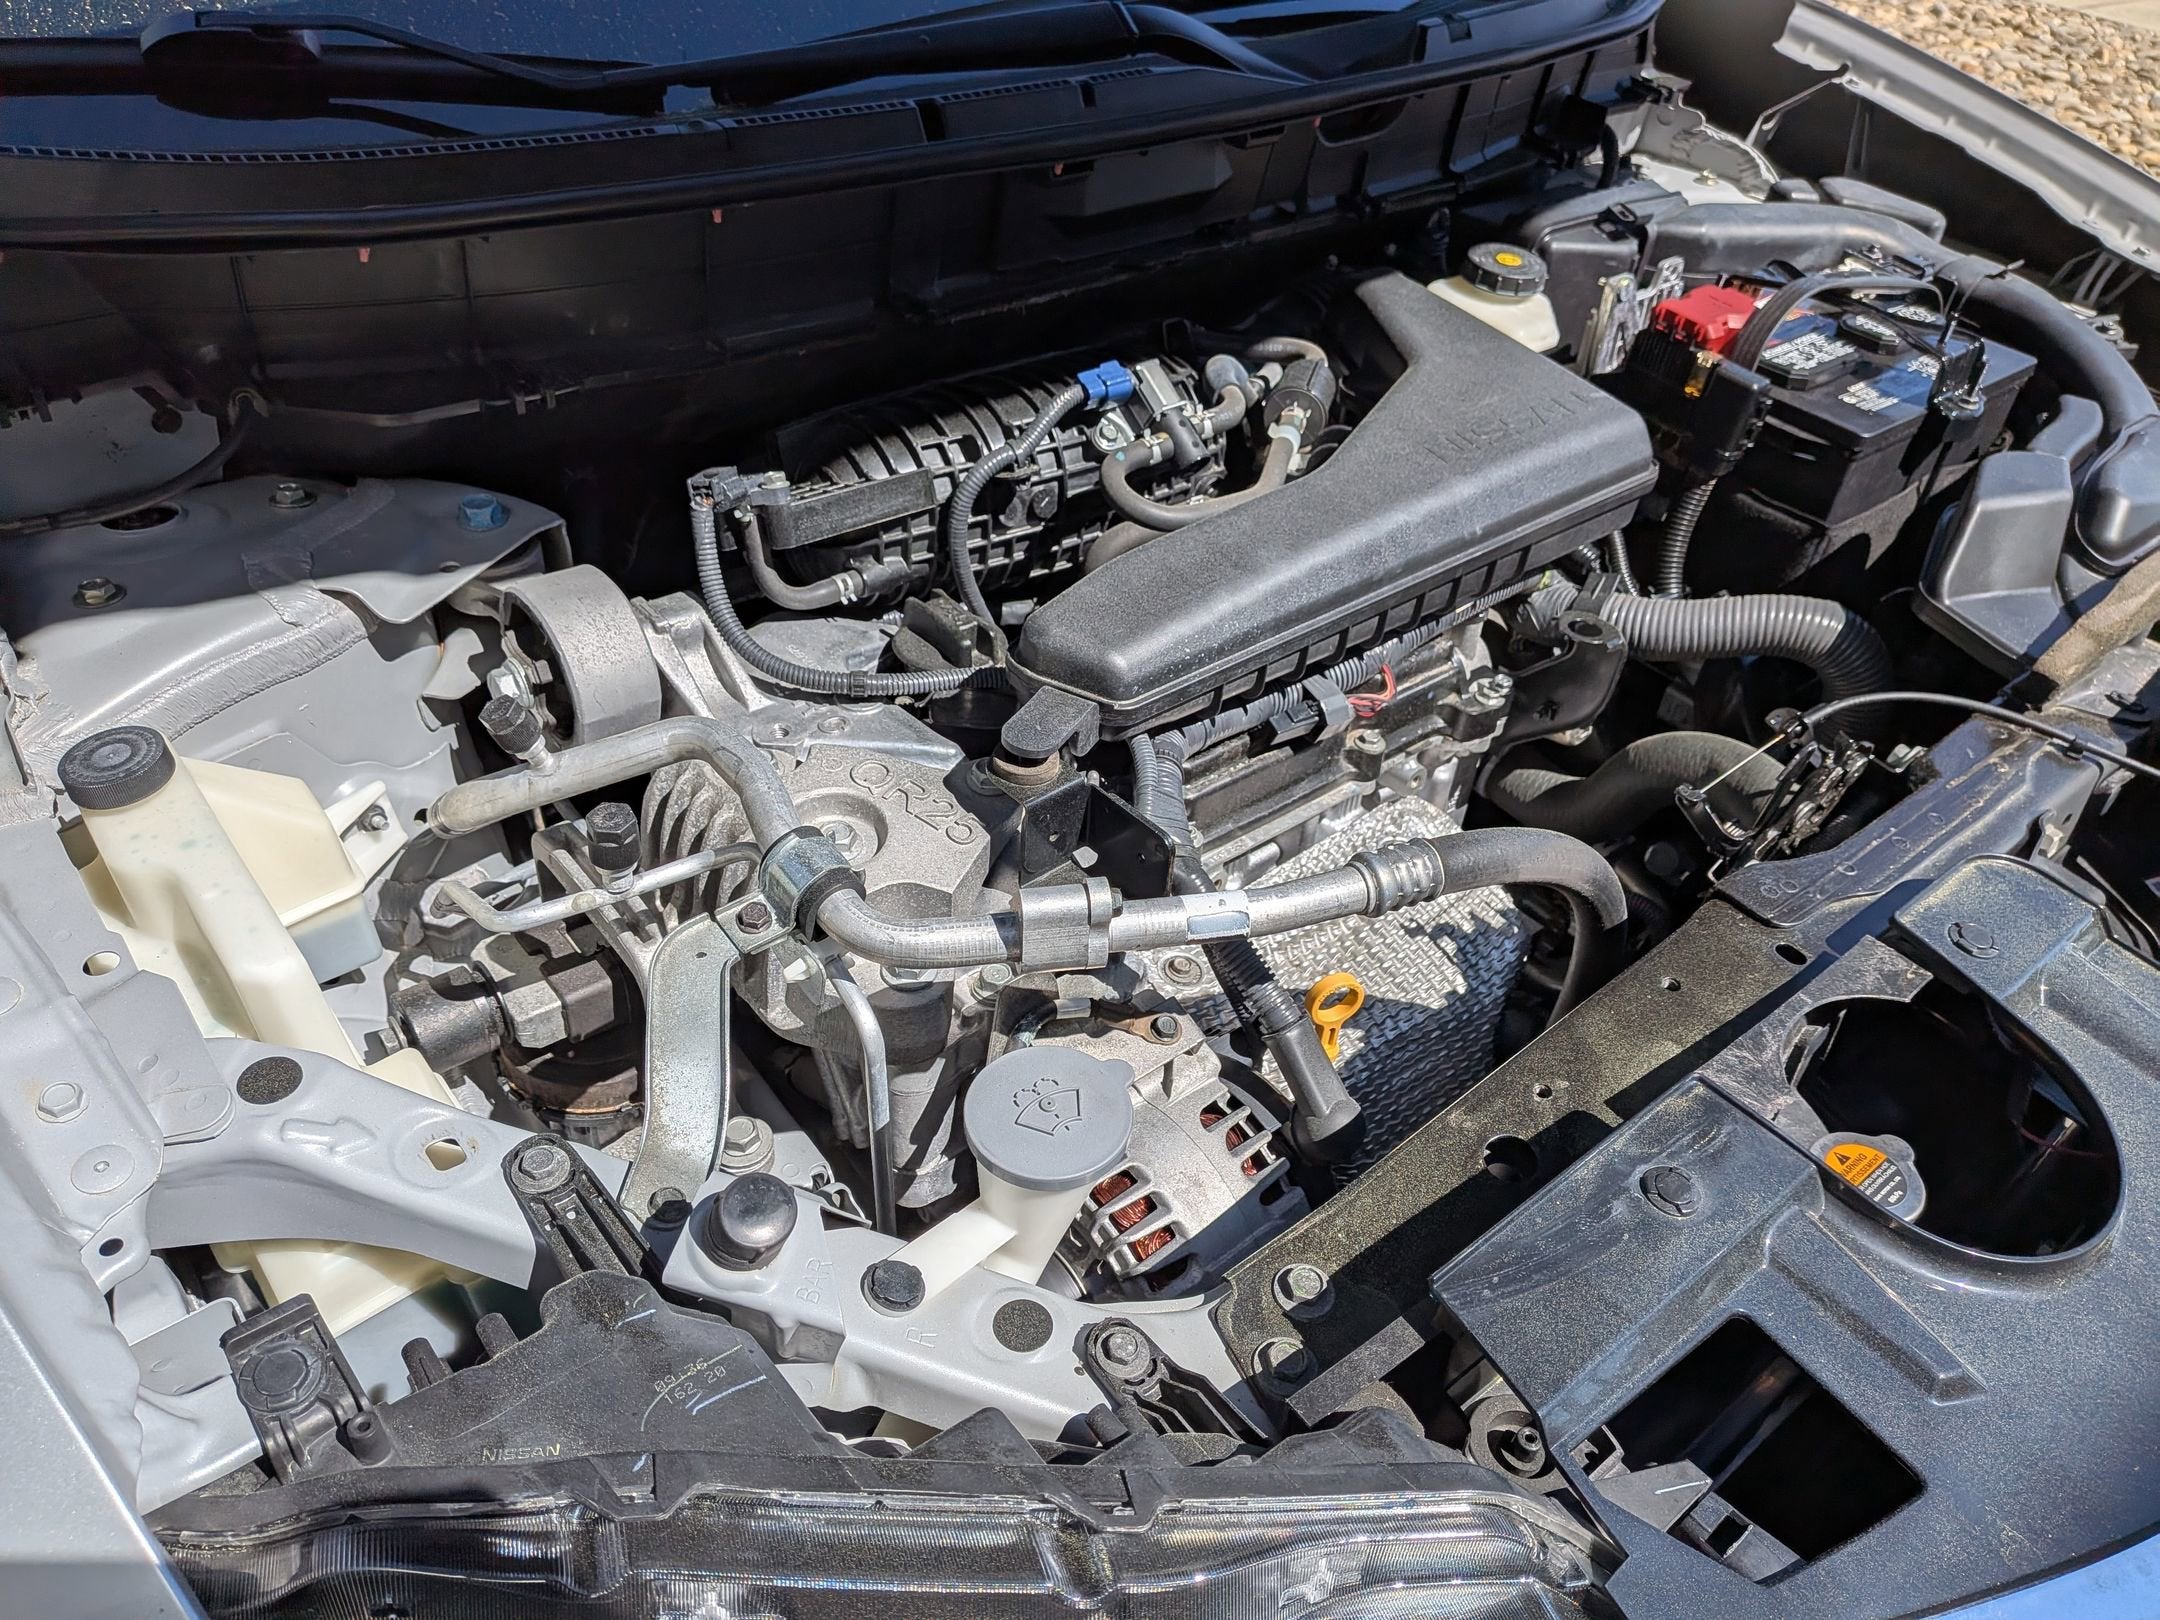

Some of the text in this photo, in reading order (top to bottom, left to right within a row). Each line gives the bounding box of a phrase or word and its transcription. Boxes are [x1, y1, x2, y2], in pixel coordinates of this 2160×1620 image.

[850, 760, 987, 846] QR25
[1849, 1153, 1883, 1184] RTISSEMENT
[795, 1257, 833, 1305] BAR
[906, 1326, 939, 1349] R
[482, 1443, 561, 1464] NISSAN
